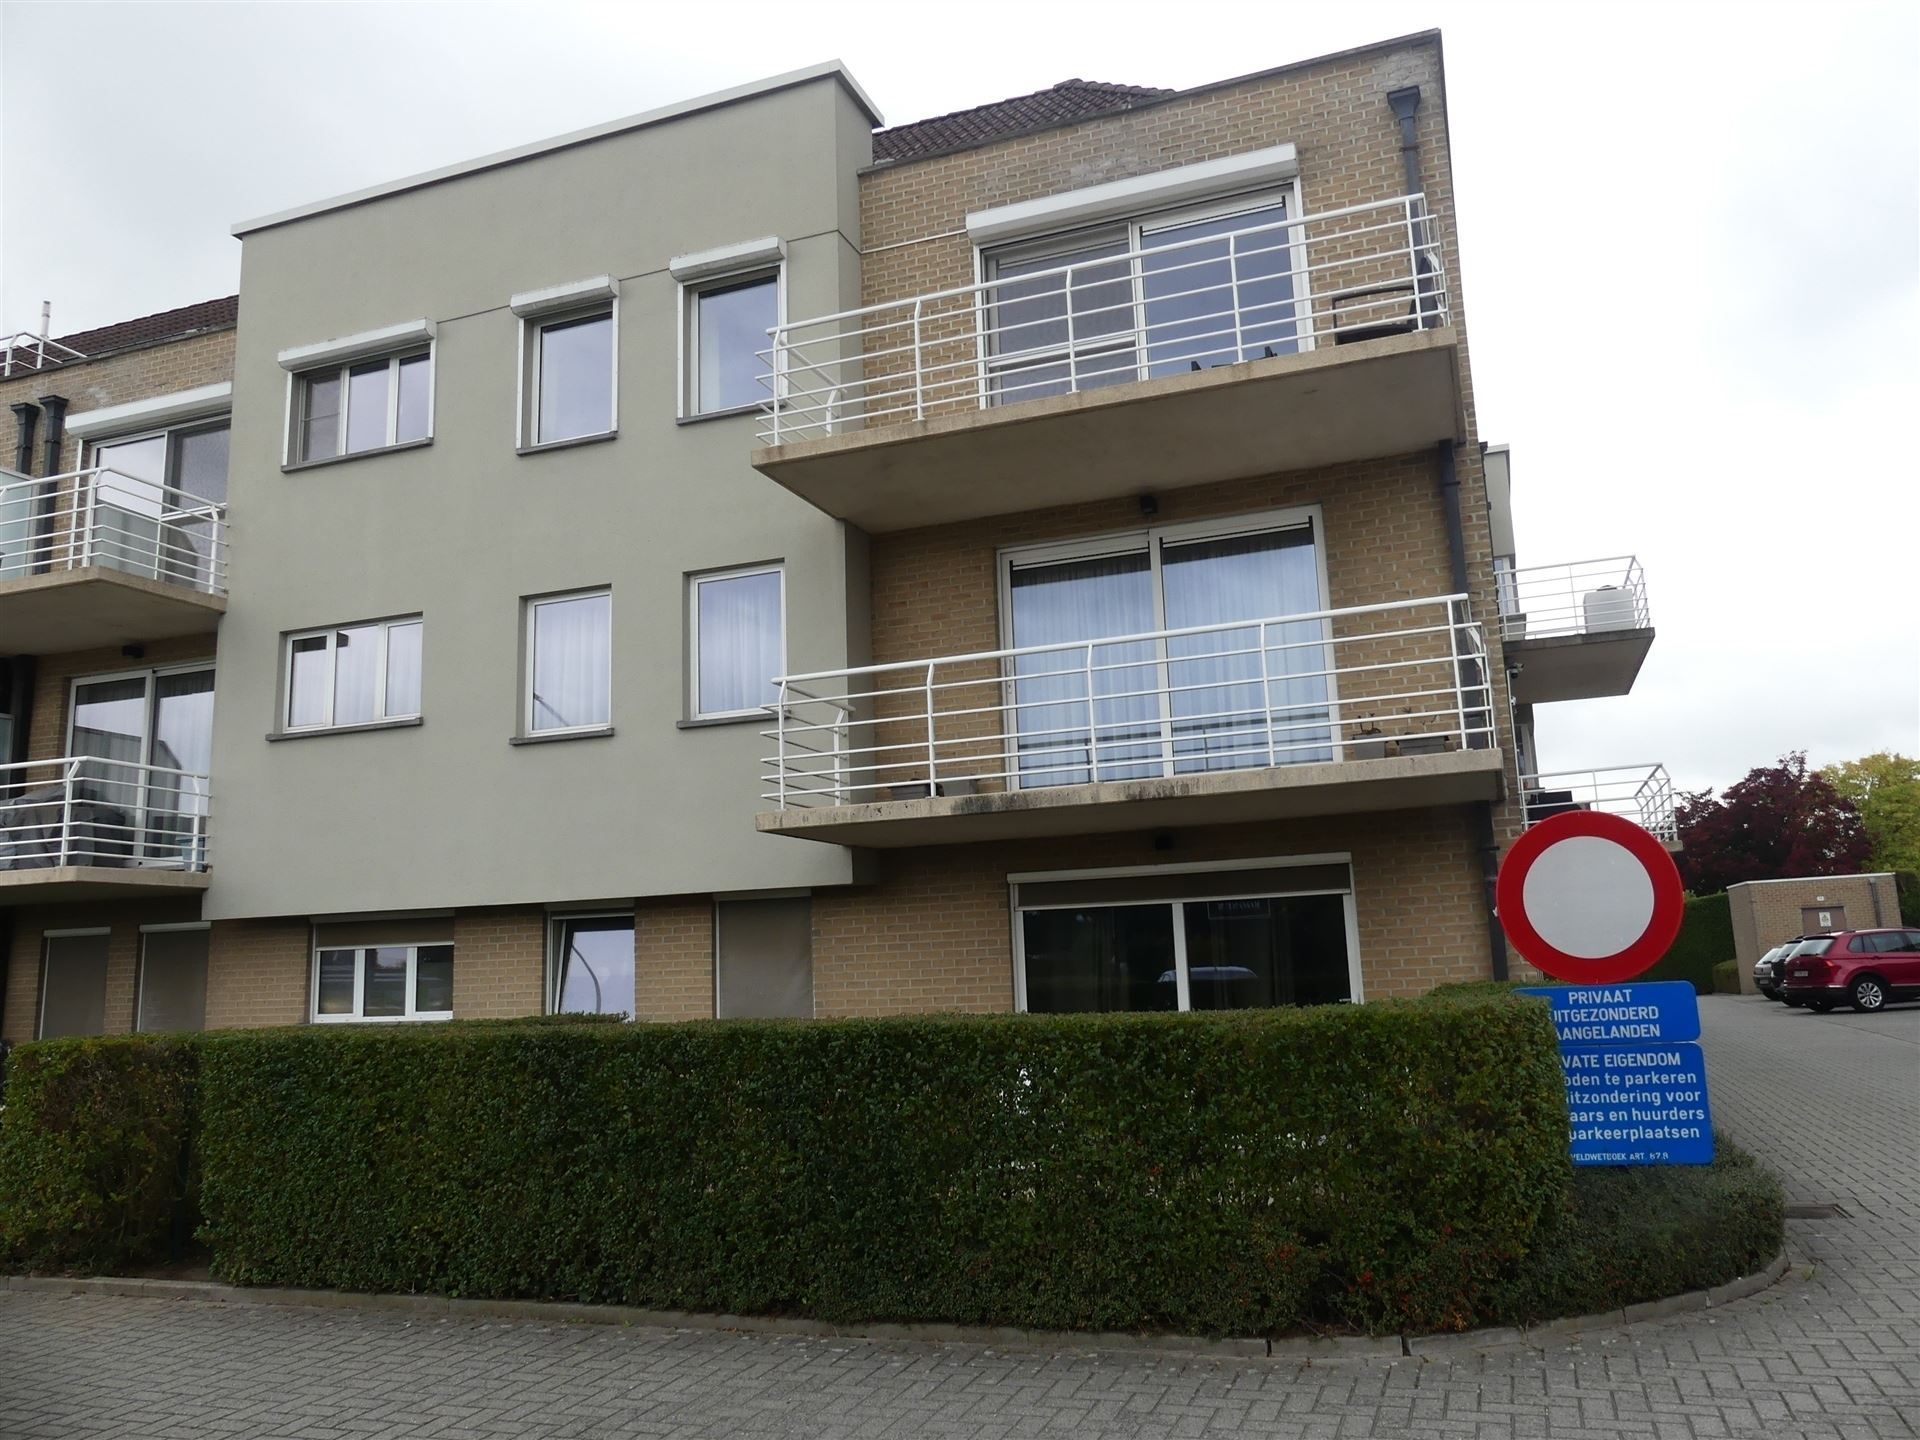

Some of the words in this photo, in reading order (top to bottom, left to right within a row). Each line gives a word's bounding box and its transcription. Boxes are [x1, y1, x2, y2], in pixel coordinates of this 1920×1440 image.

[1568, 989, 1632, 1005] PRIVAAT
[1558, 1054, 1600, 1069] VATE
[1604, 1052, 1681, 1067] EIGENDOM
[1563, 1073, 1600, 1086] oden
[1605, 1073, 1620, 1085] te
[1625, 1071, 1697, 1088] parkeren
[1666, 1090, 1701, 1102] voor
[1569, 1110, 1604, 1122] aars
[1609, 1110, 1628, 1121] en
[1632, 1107, 1704, 1121] huurders
